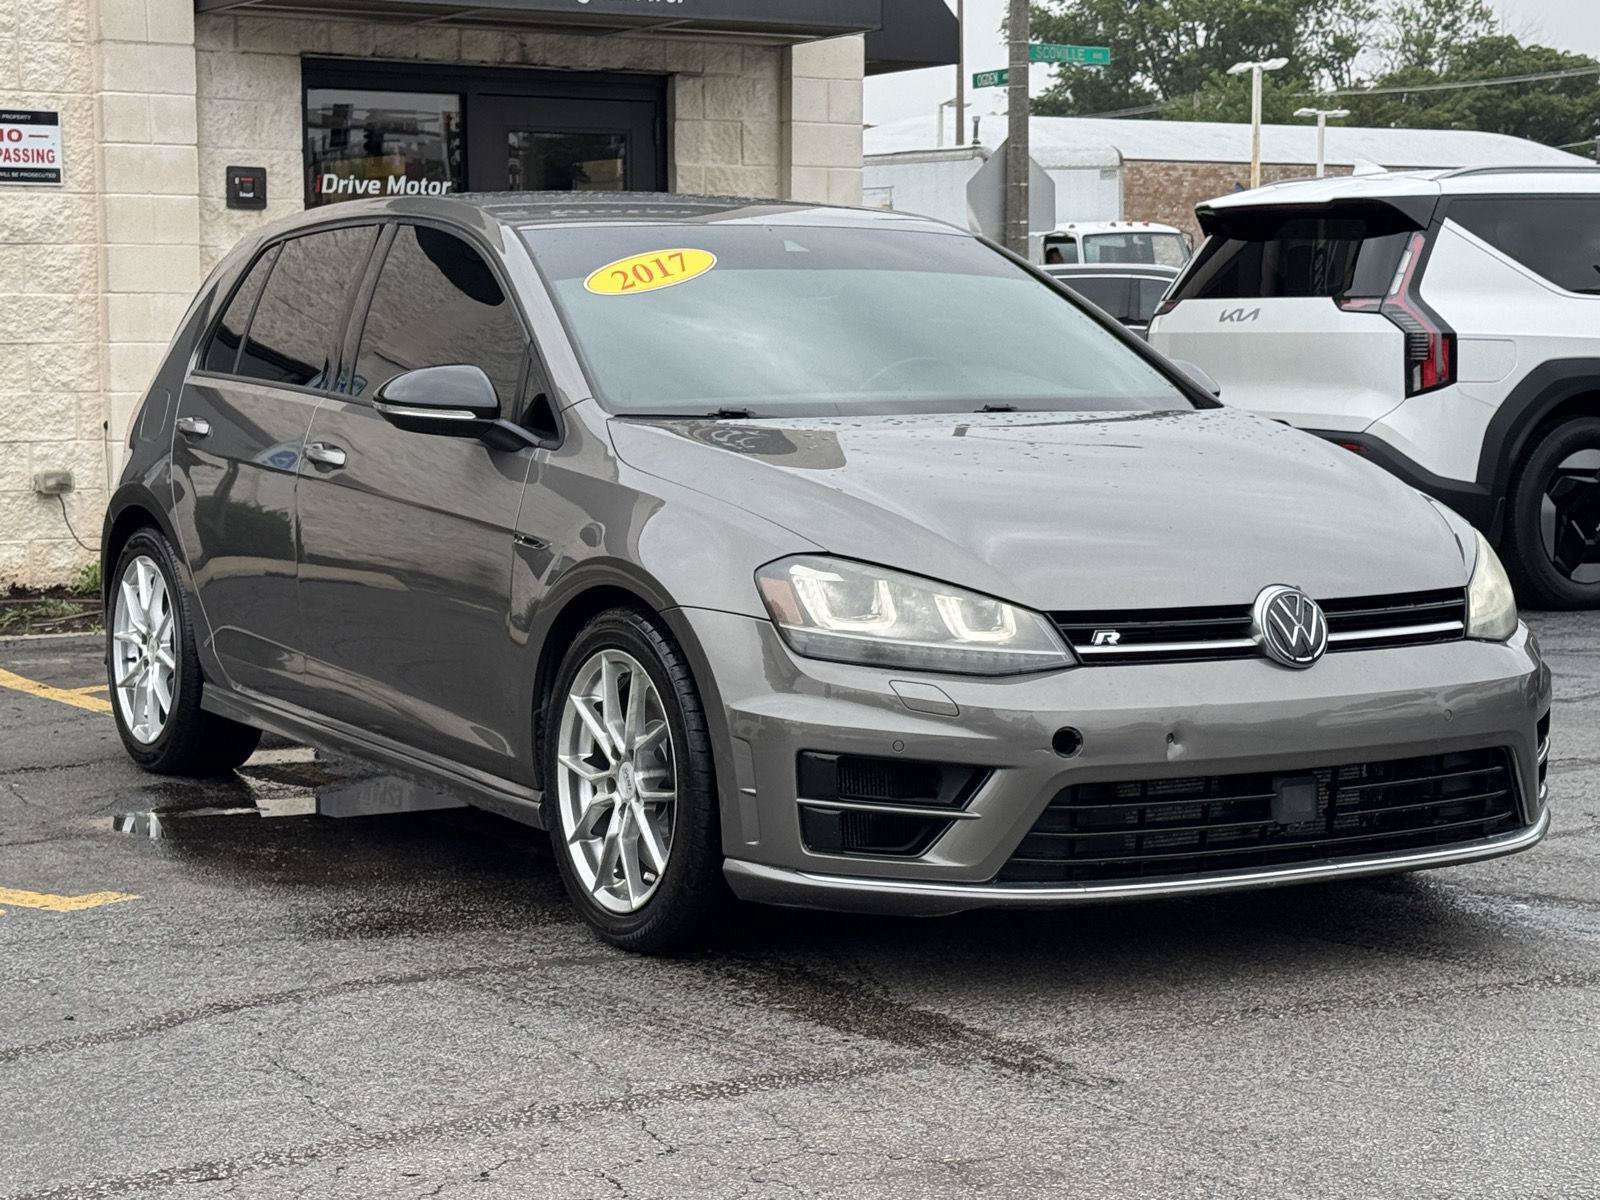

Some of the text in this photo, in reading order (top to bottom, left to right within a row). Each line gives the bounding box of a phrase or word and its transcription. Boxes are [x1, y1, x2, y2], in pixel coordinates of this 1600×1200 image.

[1035, 46, 1085, 61] SCOVILLE
[386, 175, 452, 195] Motor
[611, 252, 686, 290] 2017
[1091, 630, 1121, 646] R
